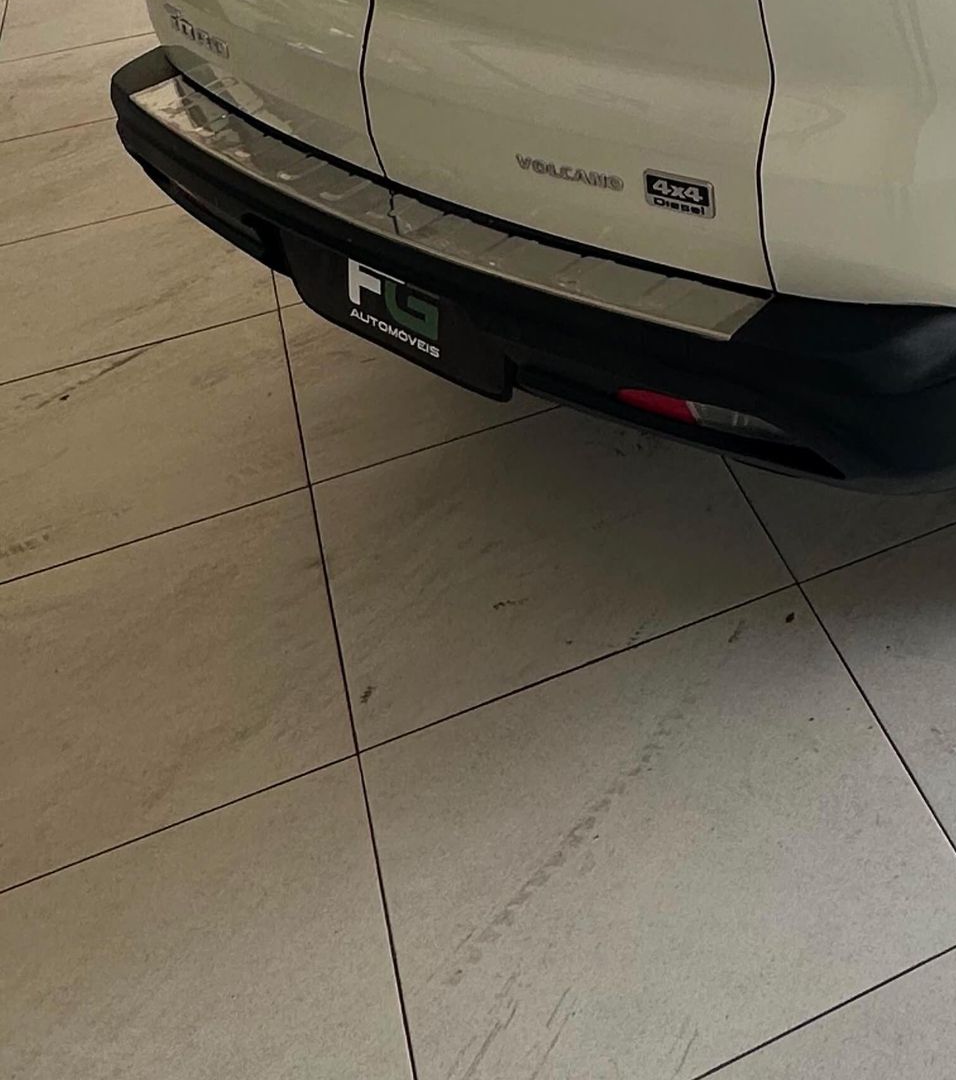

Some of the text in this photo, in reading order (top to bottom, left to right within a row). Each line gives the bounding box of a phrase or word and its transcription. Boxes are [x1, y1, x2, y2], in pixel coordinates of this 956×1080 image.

[515, 152, 625, 192] VOLCANO
[652, 178, 704, 203] 4x4
[653, 197, 706, 216] Diesel
[348, 257, 440, 340] FG
[350, 308, 441, 358] AUTOMÓVEIS
